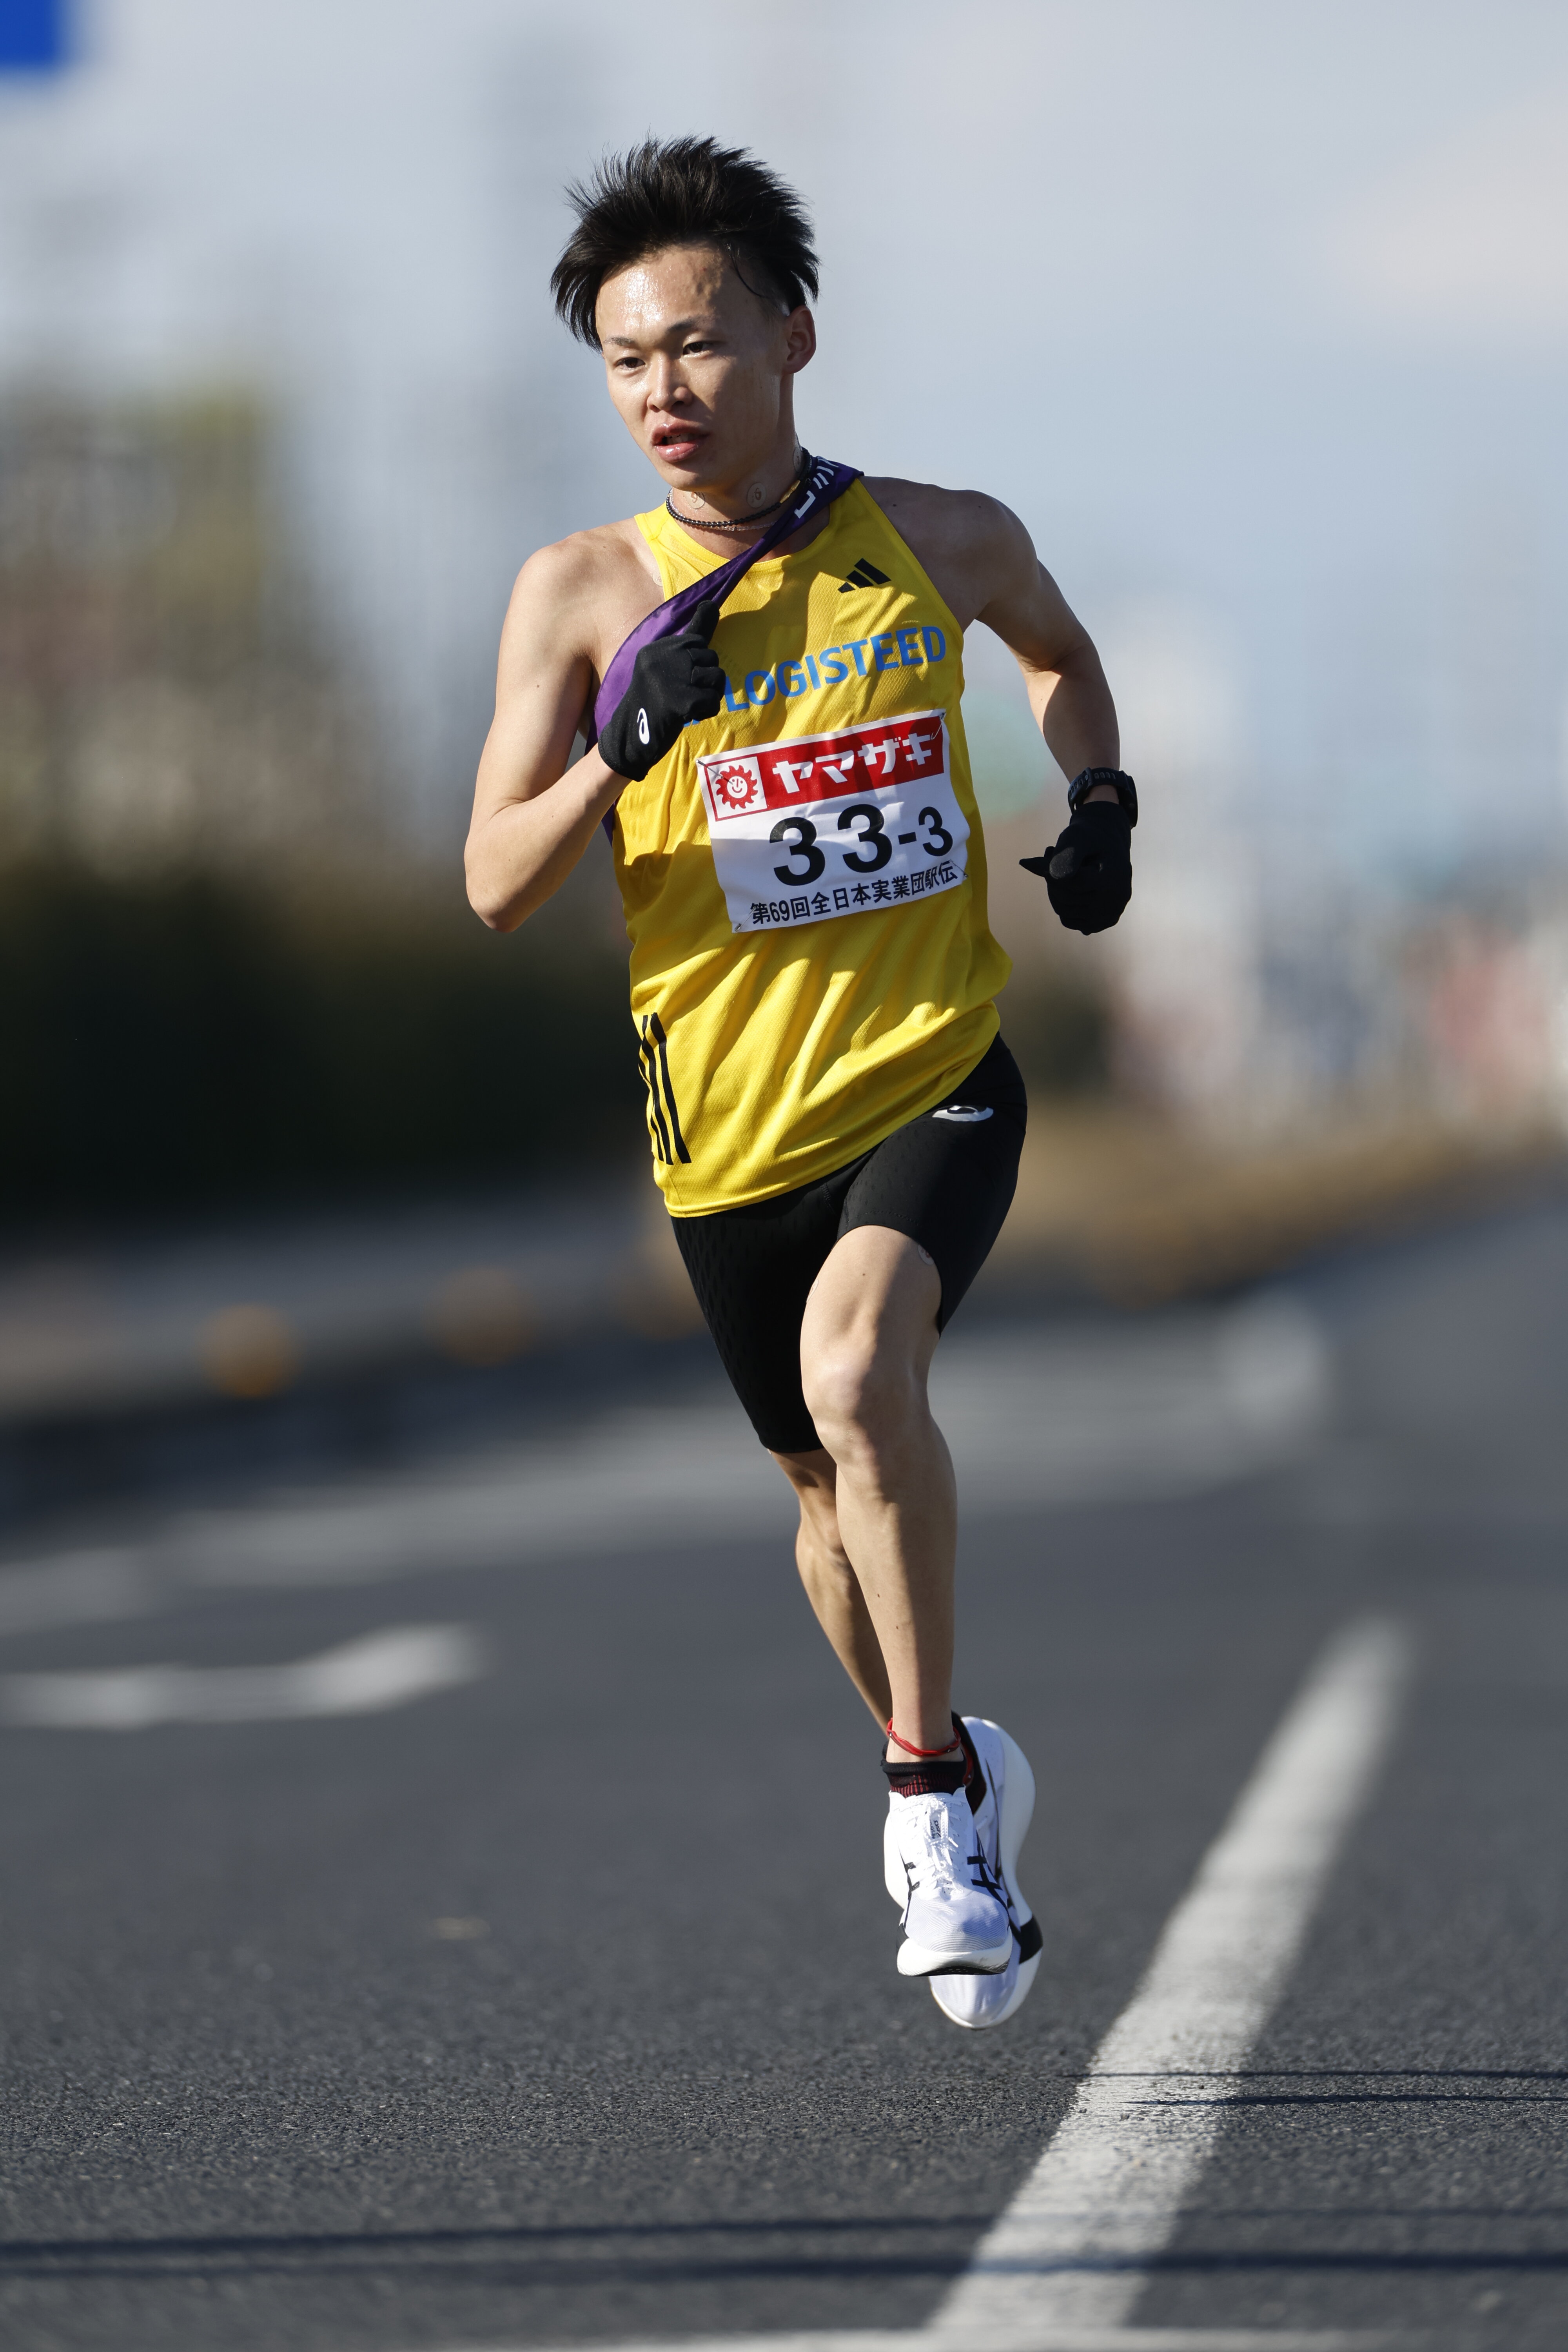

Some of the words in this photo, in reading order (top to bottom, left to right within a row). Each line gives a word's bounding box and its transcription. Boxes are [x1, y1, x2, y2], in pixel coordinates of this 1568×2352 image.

[724, 626, 946, 712] LOGISTEED
[773, 733, 934, 794] ヤマザキ
[769, 804, 953, 887] 33-3
[750, 860, 958, 925] 第69回全日本実業団駅伝
